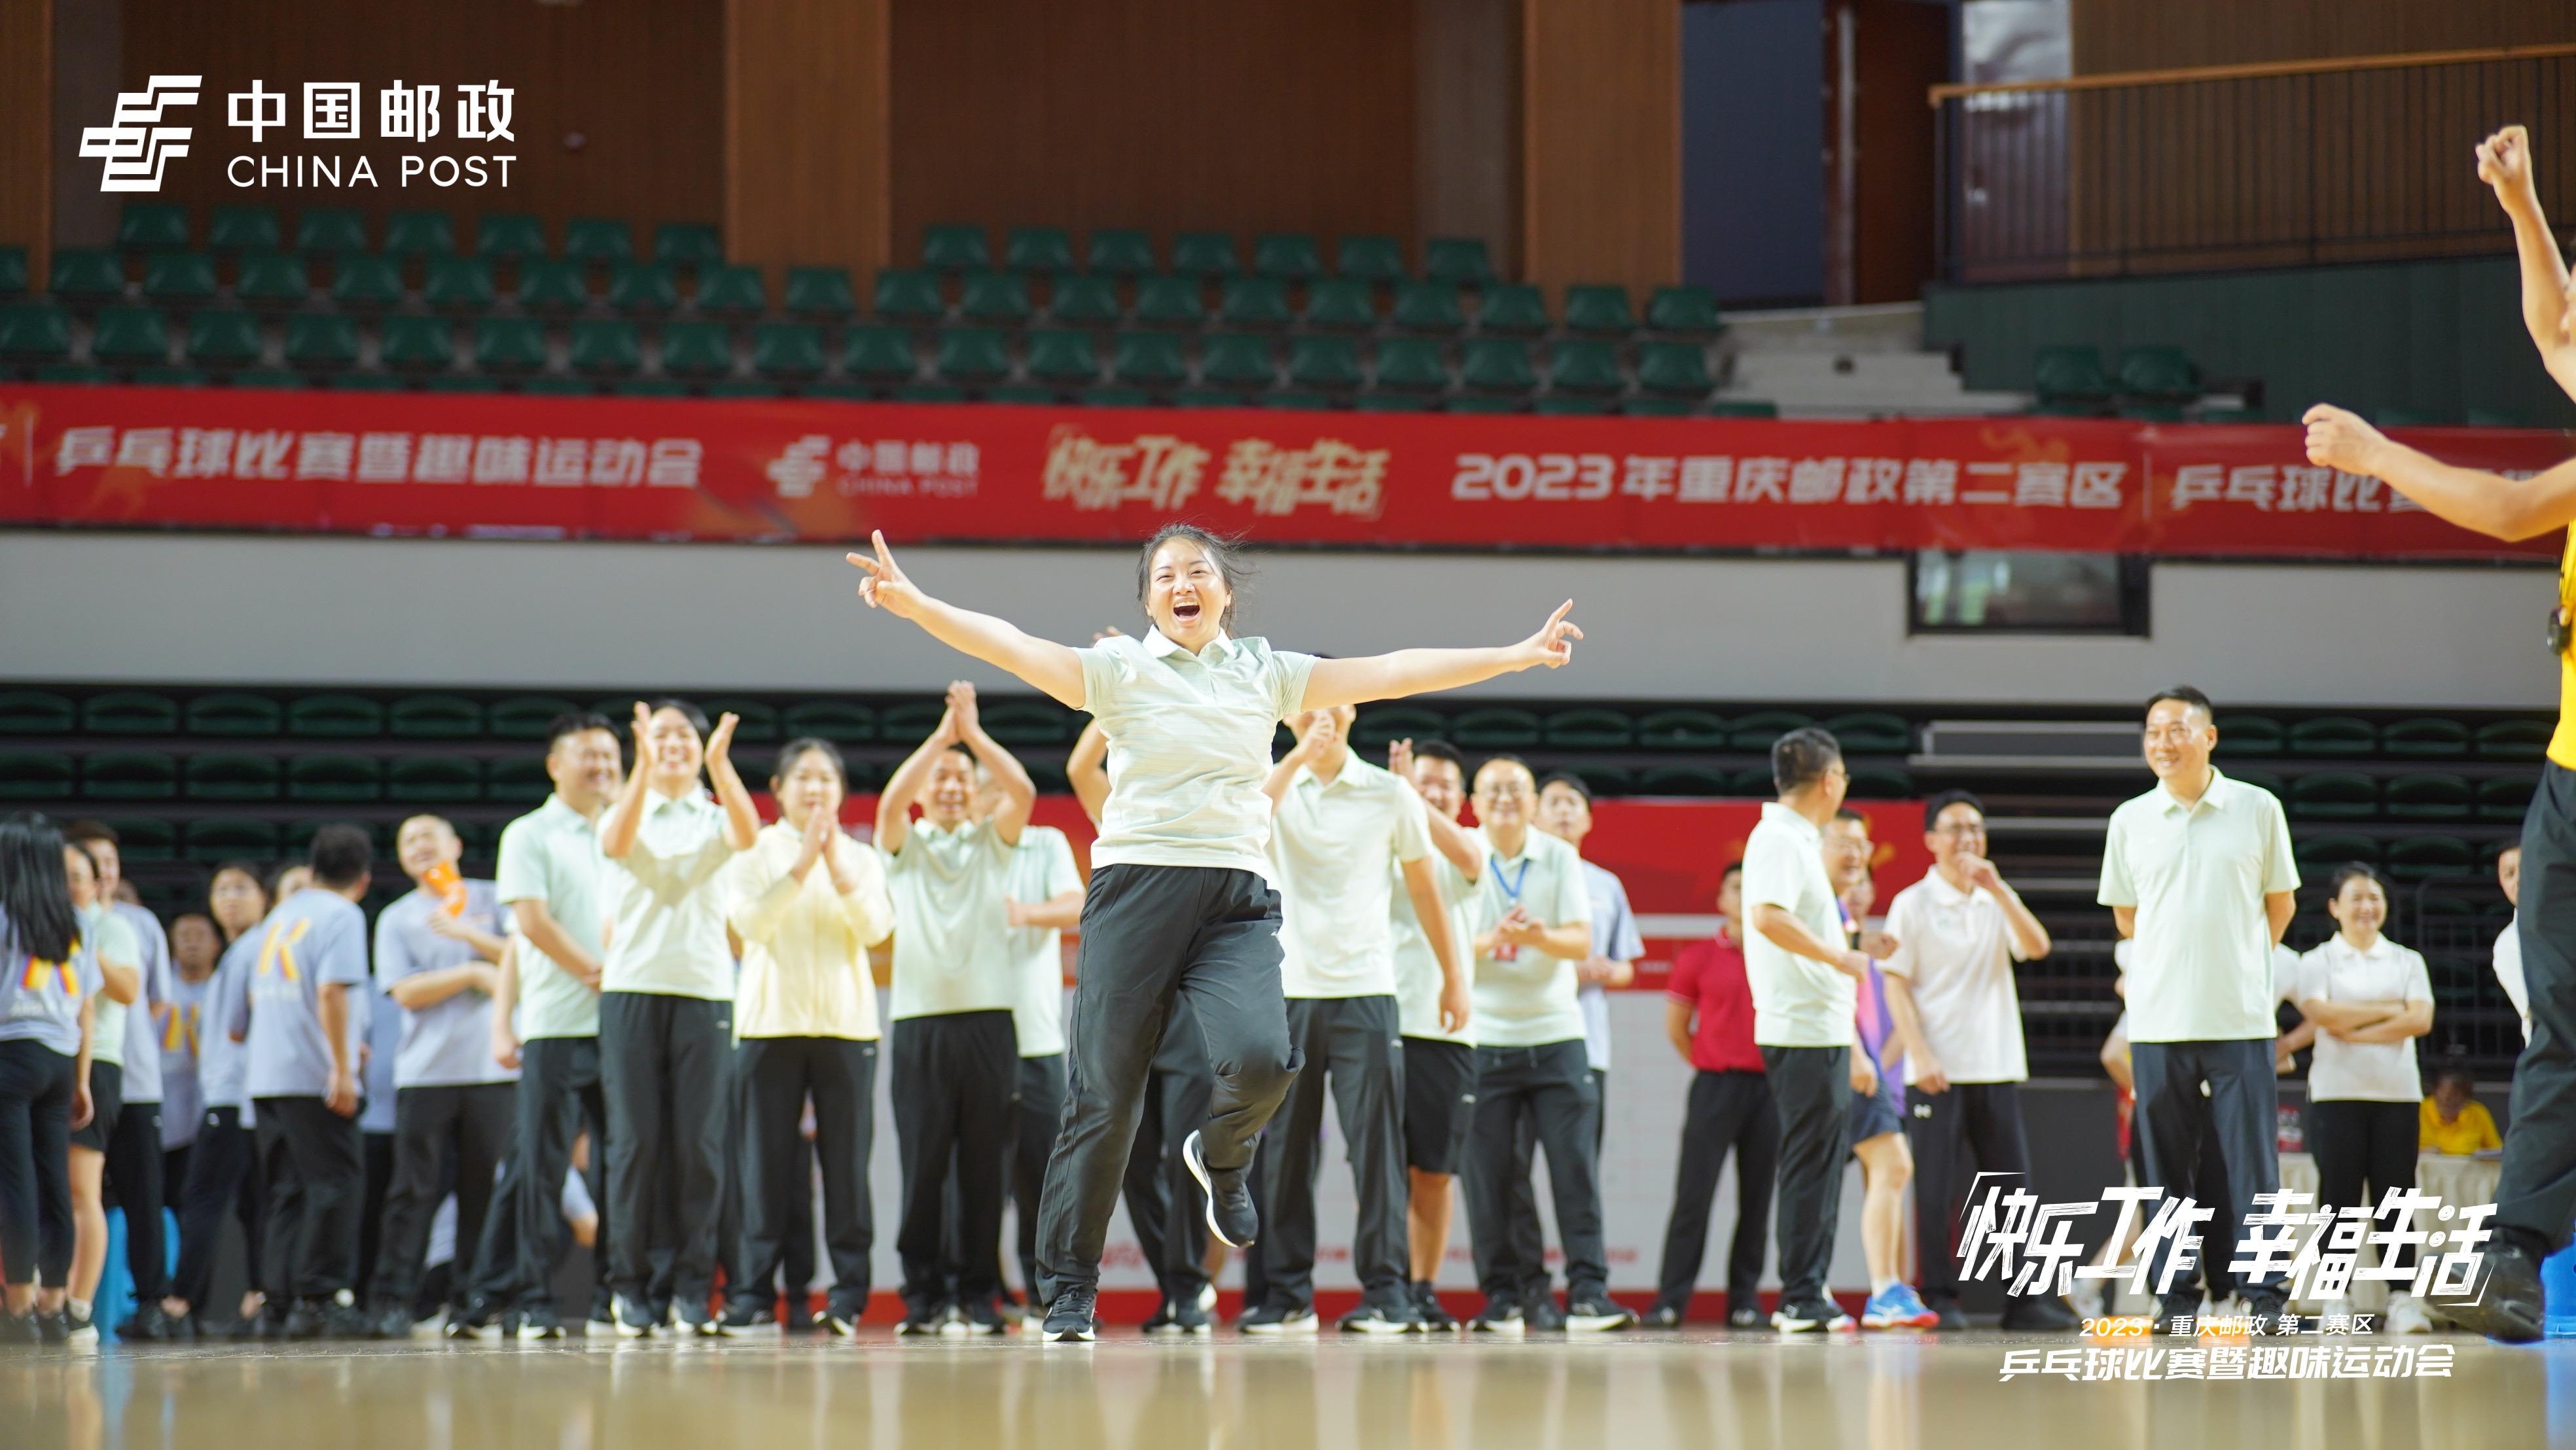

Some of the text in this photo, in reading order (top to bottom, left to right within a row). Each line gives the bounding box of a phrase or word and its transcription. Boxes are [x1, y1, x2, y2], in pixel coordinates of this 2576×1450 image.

[56, 426, 703, 487] 乒乓球比赛暨趣味运动会
[1450, 453, 2128, 509] 2023年重庆邮政第二赛区
